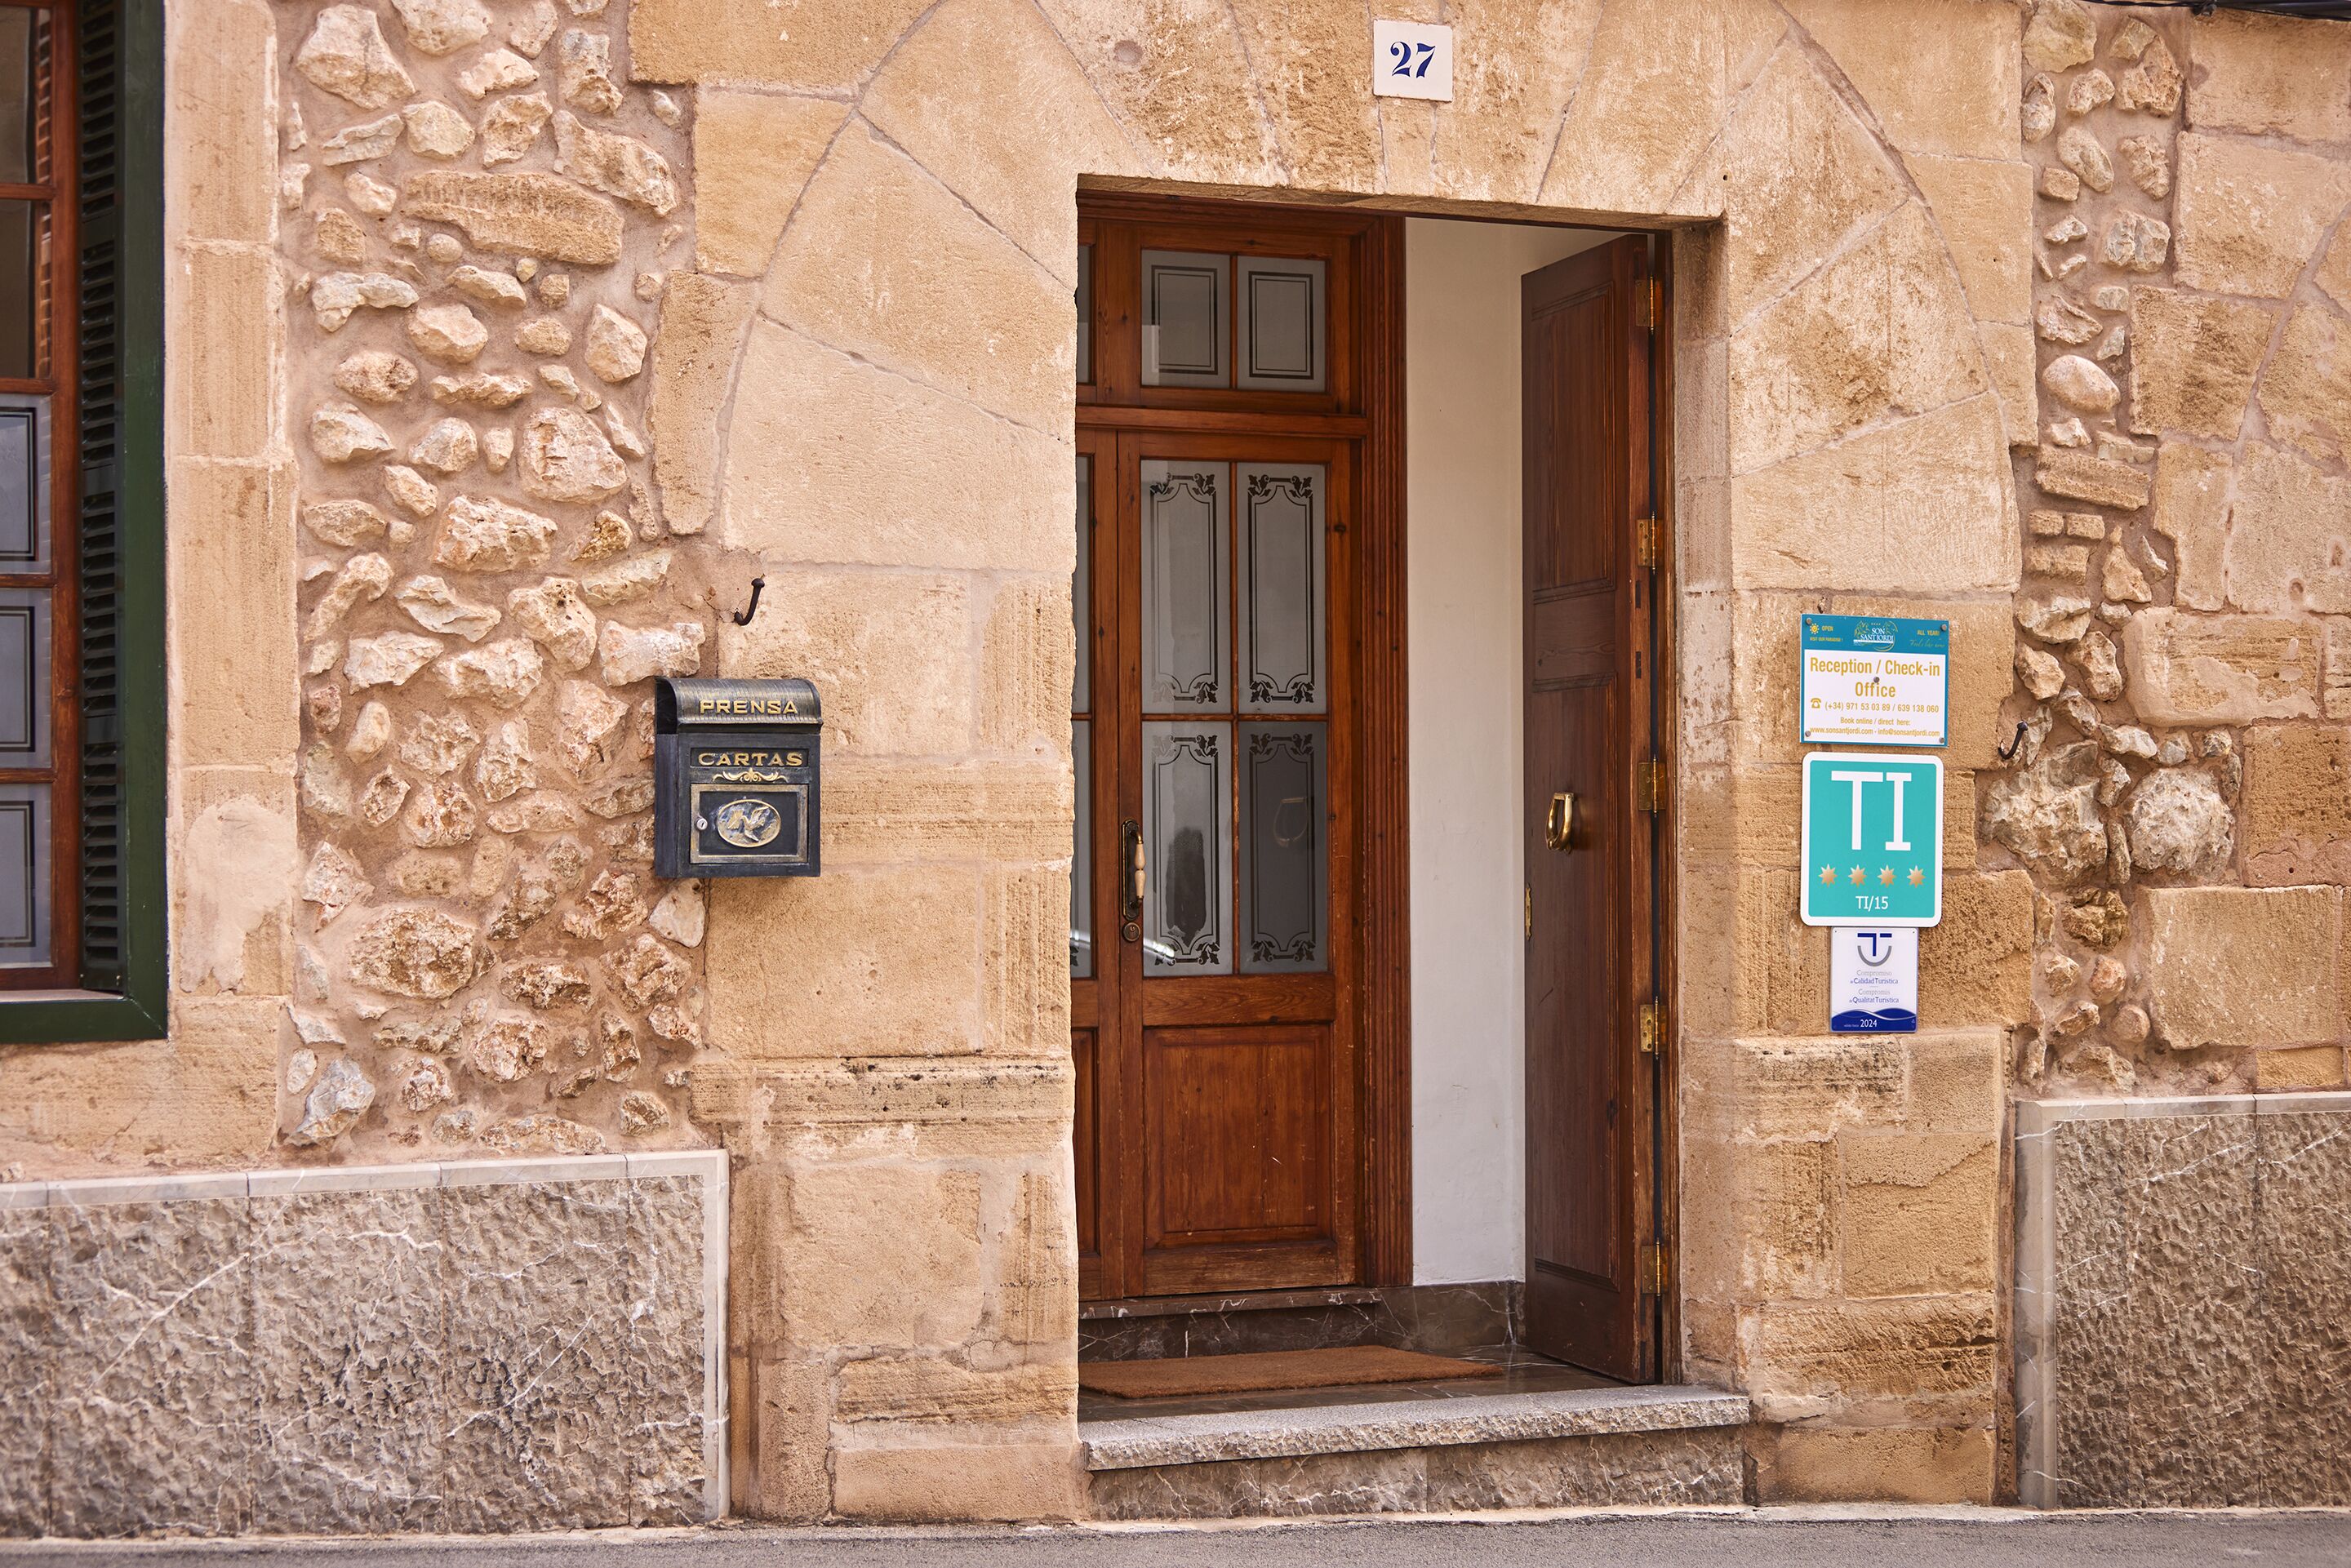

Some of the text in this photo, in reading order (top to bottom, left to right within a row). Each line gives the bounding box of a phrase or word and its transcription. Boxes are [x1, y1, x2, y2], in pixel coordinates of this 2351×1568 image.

[1390, 41, 1436, 78] 27
[1871, 627, 1886, 635] SON
[1810, 656, 1940, 677] Reception / Check-in
[1855, 682, 1896, 698] Office
[700, 700, 798, 714] PRENSA
[1824, 701, 1940, 713] (+34) 971 53 03 89 / 639 138 060
[1810, 726, 1873, 735] www.sonsantjordi.com
[1878, 728, 1940, 737] info@sonsantjordi.com
[698, 753, 803, 766] CARTAS
[1831, 770, 1912, 851] TI
[1855, 895, 1889, 912] TI/15
[1856, 969, 1892, 977] Compromiso
[1860, 1019, 1878, 1028] 2024
